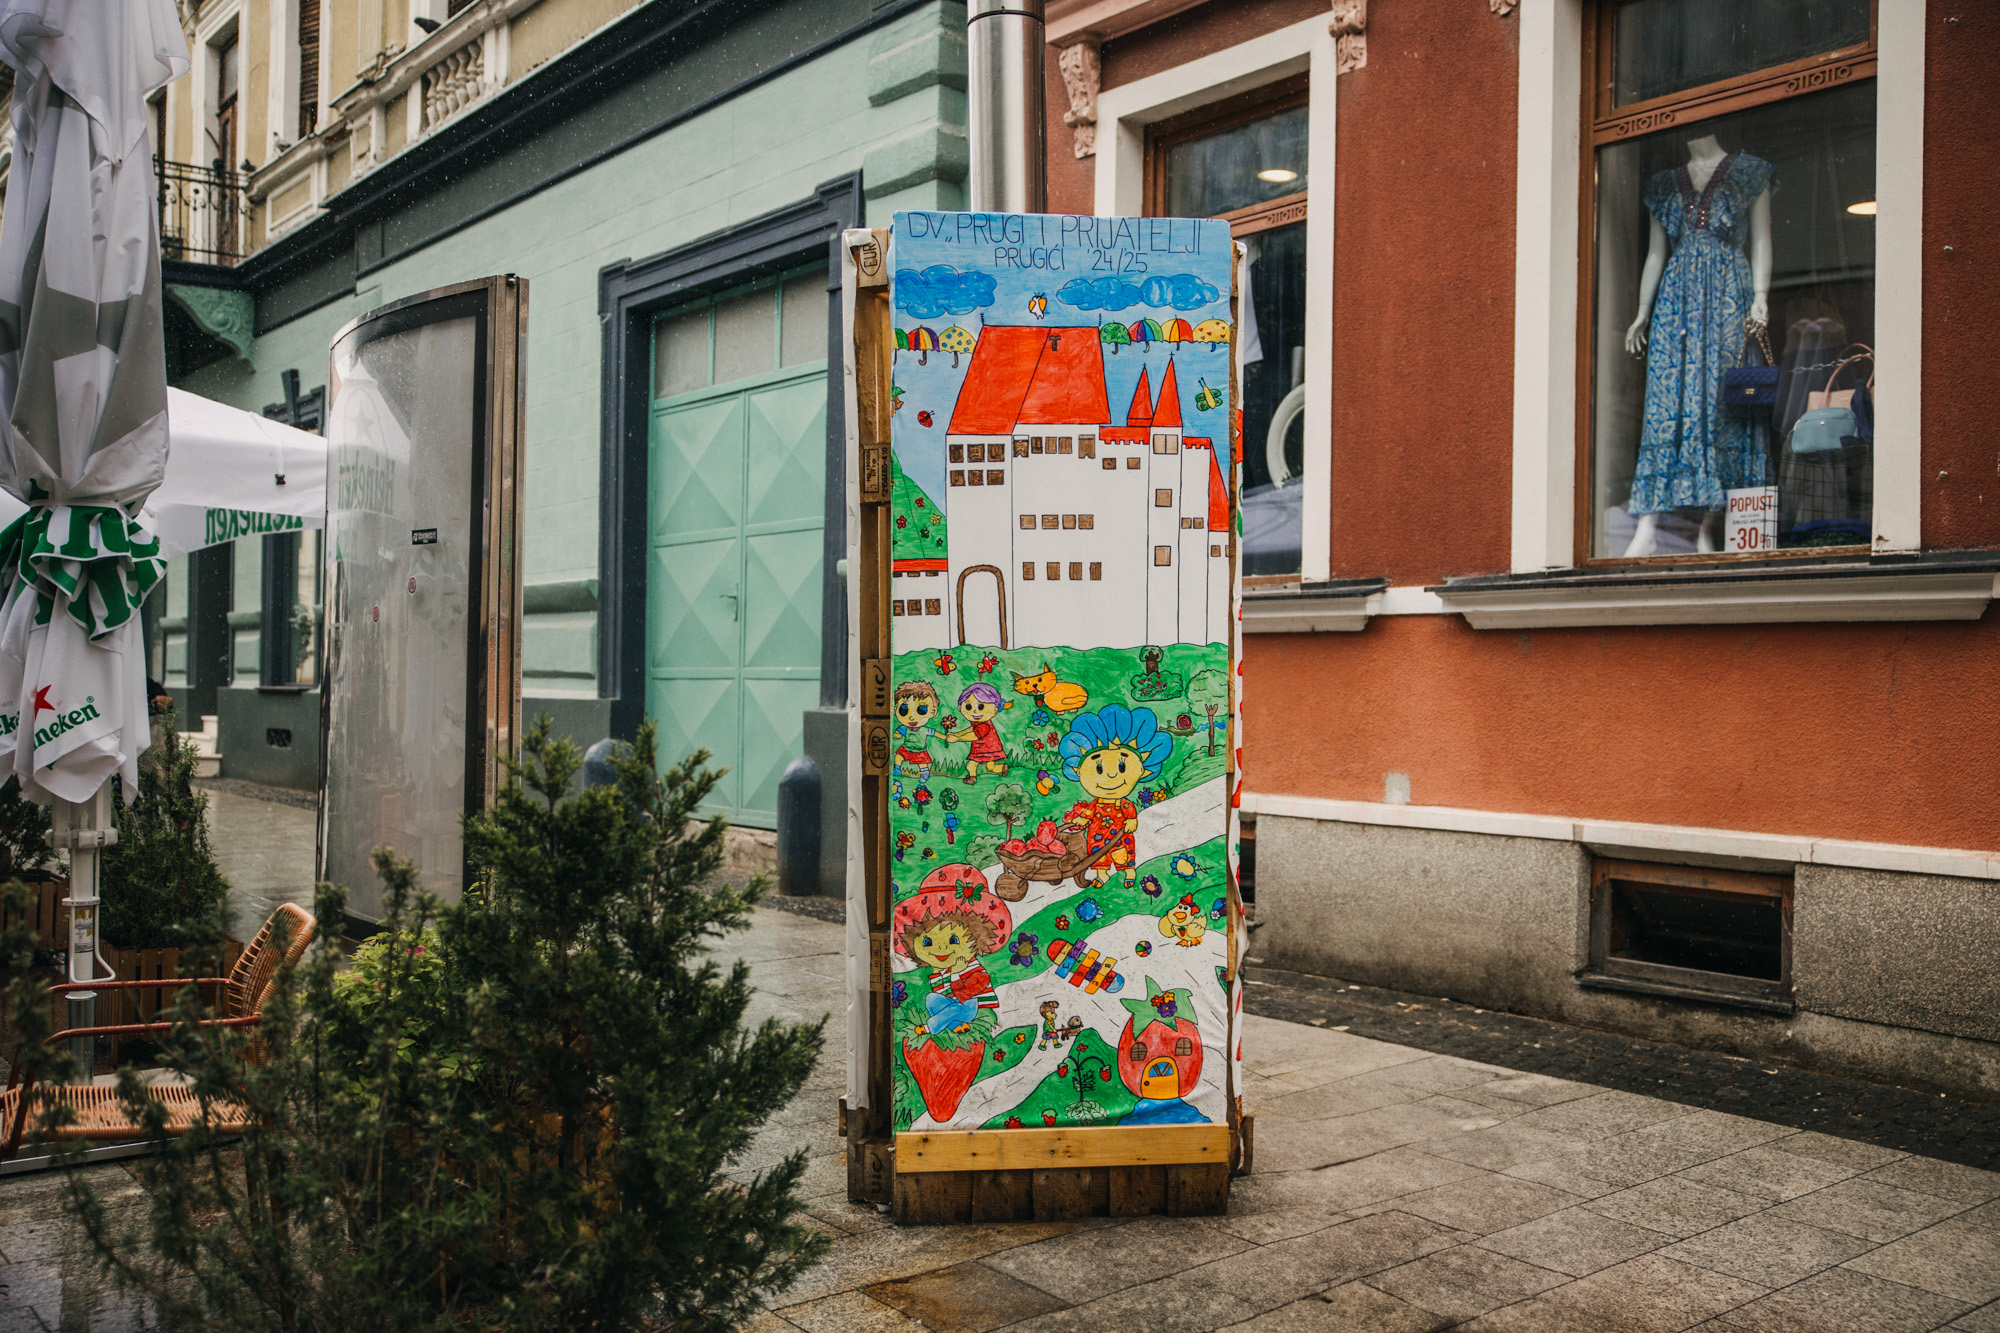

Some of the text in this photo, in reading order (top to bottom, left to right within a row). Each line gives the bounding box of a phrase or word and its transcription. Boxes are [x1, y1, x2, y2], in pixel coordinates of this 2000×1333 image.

[907, 212, 946, 238] DV
[1040, 216, 1046, 246] I
[863, 243, 878, 267] EUR
[994, 243, 1065, 271] PRUGIĆI
[1730, 495, 1774, 513] POPUST
[1730, 527, 1772, 549] -30%
[871, 735, 887, 760] EUR
